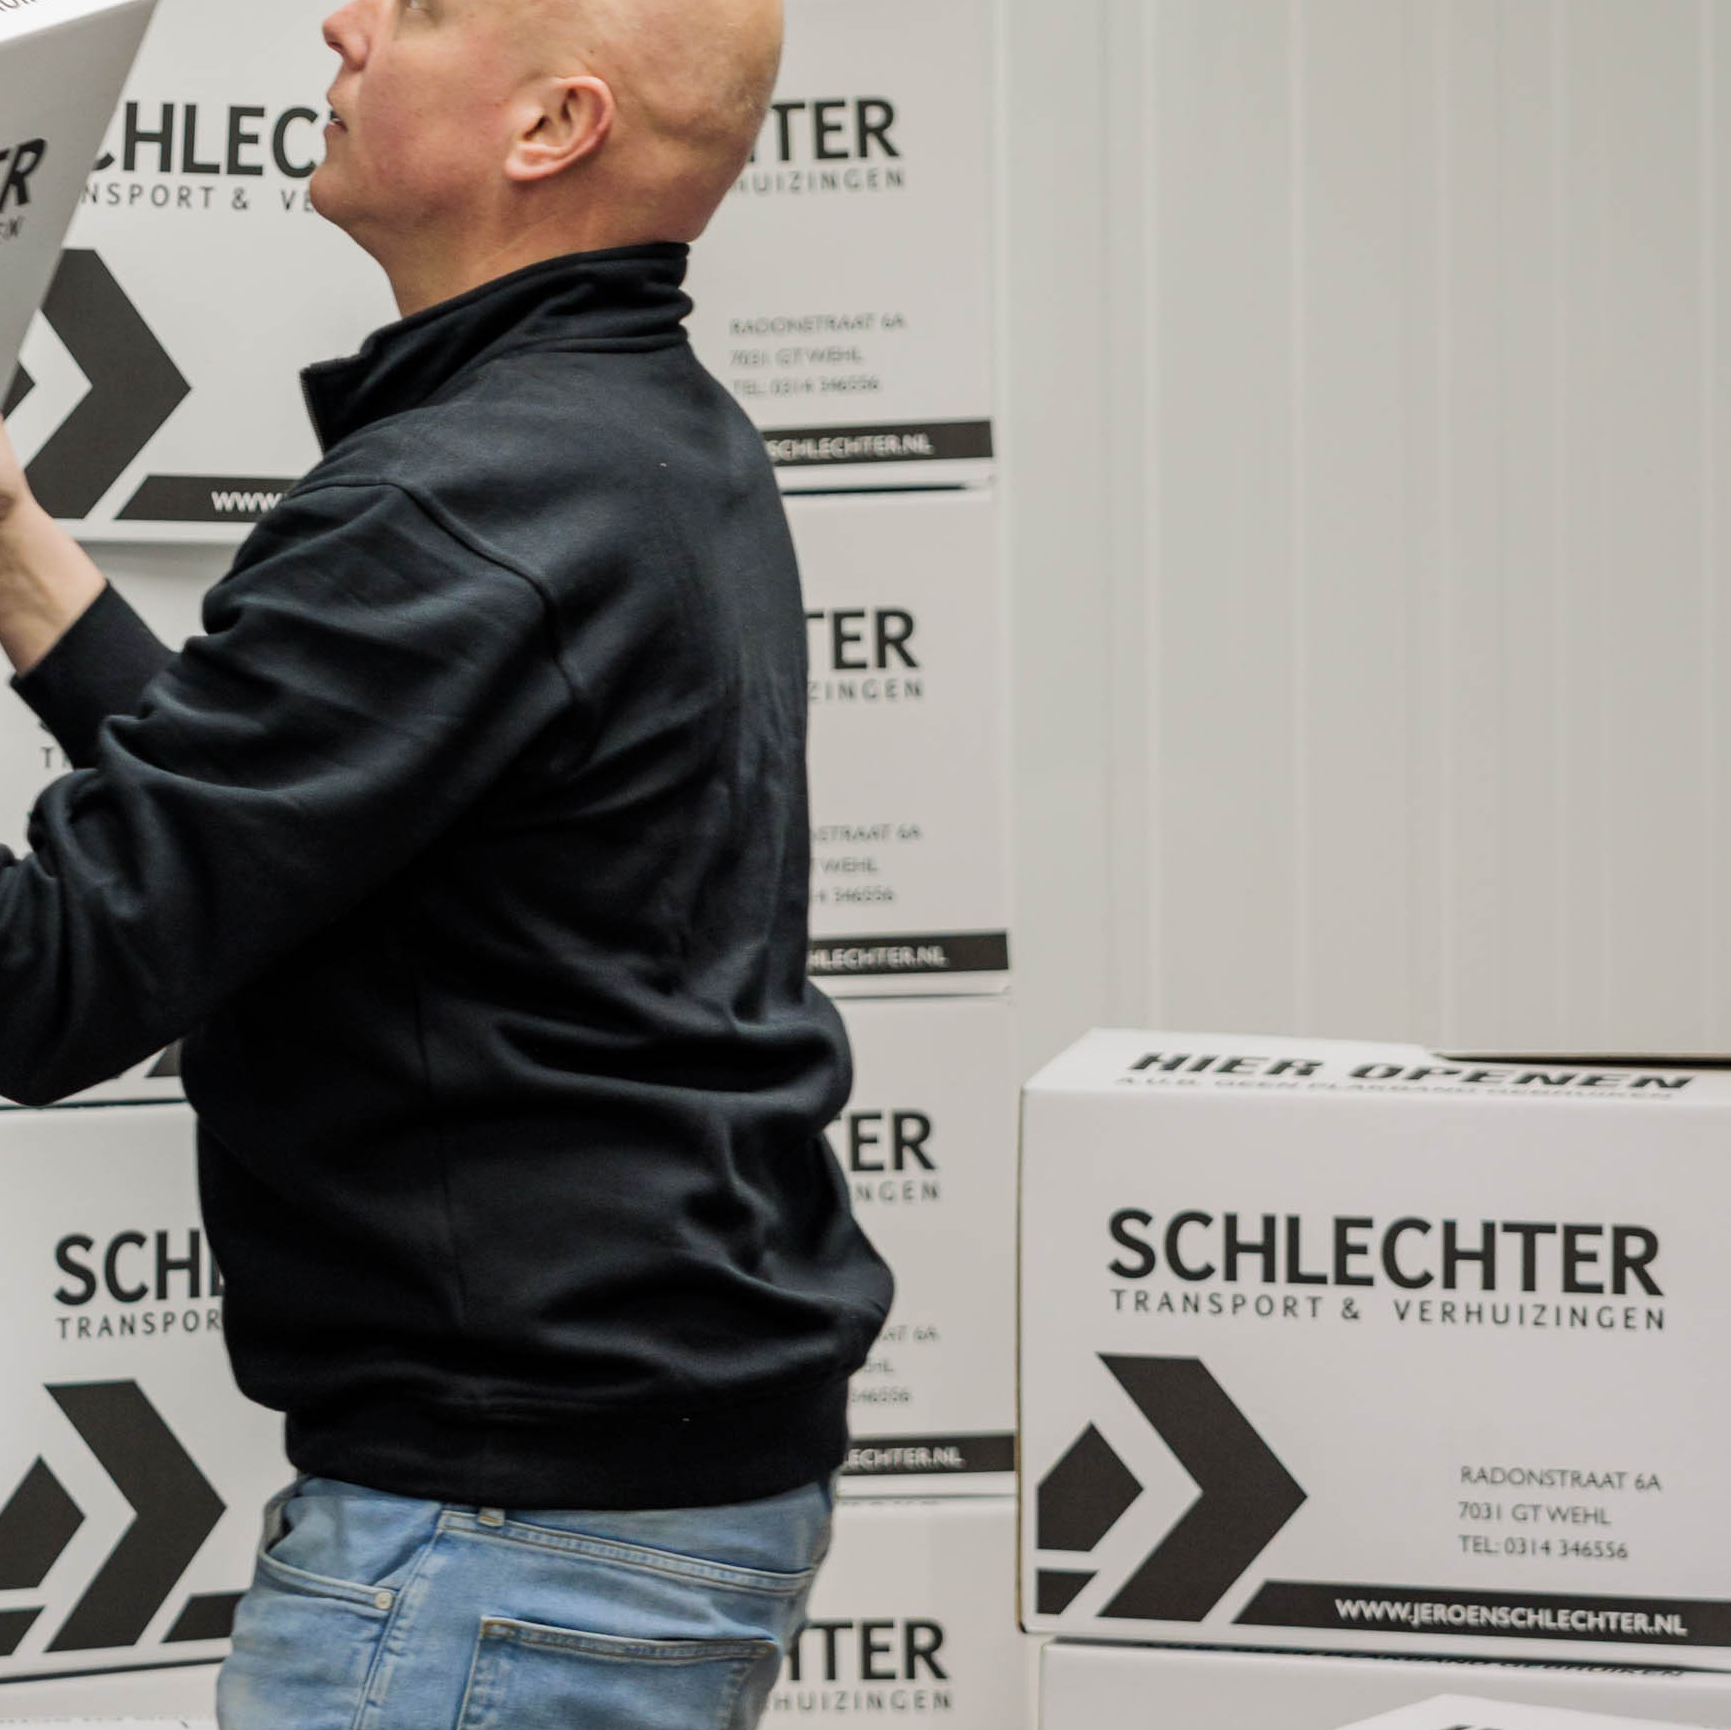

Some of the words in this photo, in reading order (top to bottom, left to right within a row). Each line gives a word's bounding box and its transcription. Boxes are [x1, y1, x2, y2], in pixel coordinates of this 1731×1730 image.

[91, 101, 340, 179] HLEC
[748, 98, 901, 164] TER
[232, 188, 249, 211] &
[1130, 1052, 1324, 1076] HIER
[1349, 1061, 1695, 1089] OPENEN
[831, 1109, 936, 1173] ER
[1106, 1206, 1665, 1298] SCHLECHTER
[1110, 1287, 1323, 1320] TRANSPORT
[1341, 1296, 1361, 1321] &
[1393, 1298, 1665, 1332] VERHUIZINGEN
[1459, 1465, 1627, 1492] RADONSTRAAT
[1634, 1471, 1662, 1492] 6A
[1458, 1500, 1503, 1522] 7031
[1511, 1502, 1542, 1525] GT
[1547, 1504, 1613, 1527] WEHL
[1558, 1538, 1629, 1561] 346556
[1335, 1598, 1687, 1634] WWW.JEROENSCHLECHTER.NL
